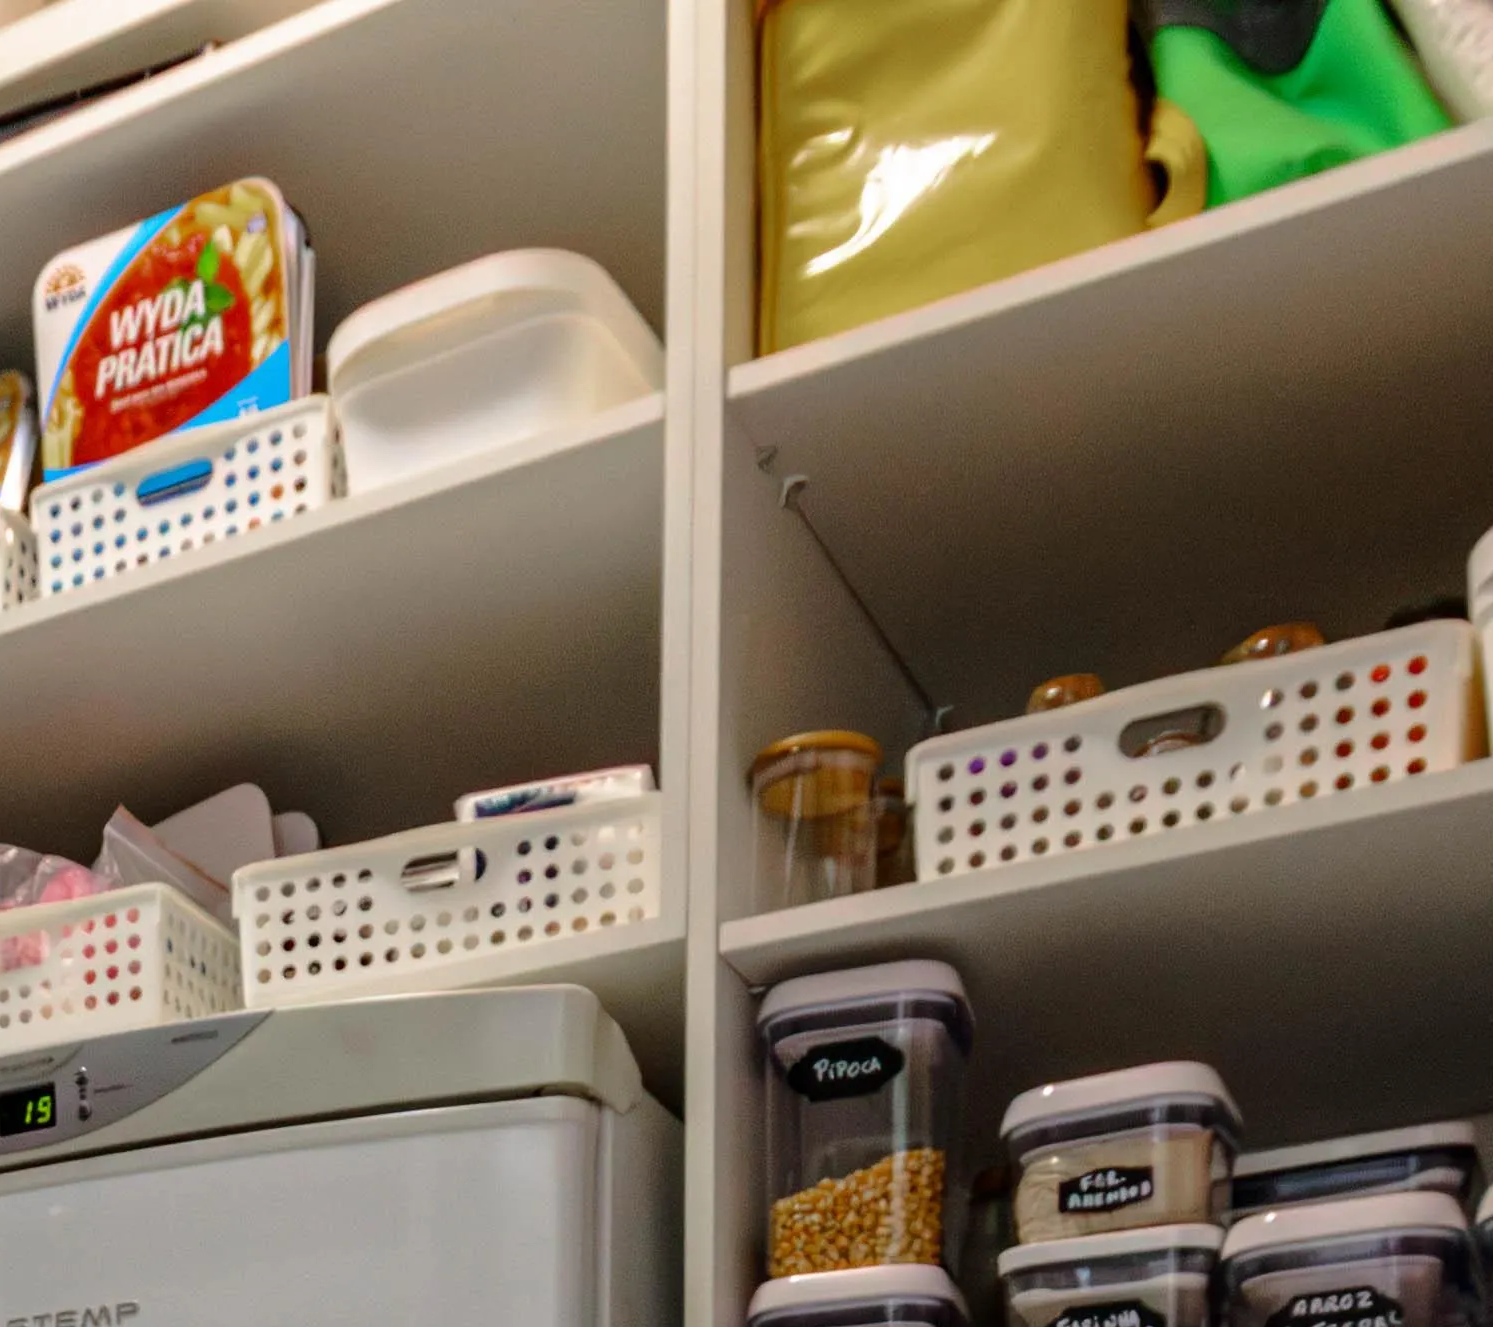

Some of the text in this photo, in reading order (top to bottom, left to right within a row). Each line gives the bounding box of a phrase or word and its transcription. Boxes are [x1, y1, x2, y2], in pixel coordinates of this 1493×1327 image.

[109, 279, 206, 349] WYDA
[94, 316, 224, 399] PRATICA
[24, 1095, 51, 1124] 19
[1292, 1290, 1374, 1318] ARROZ
